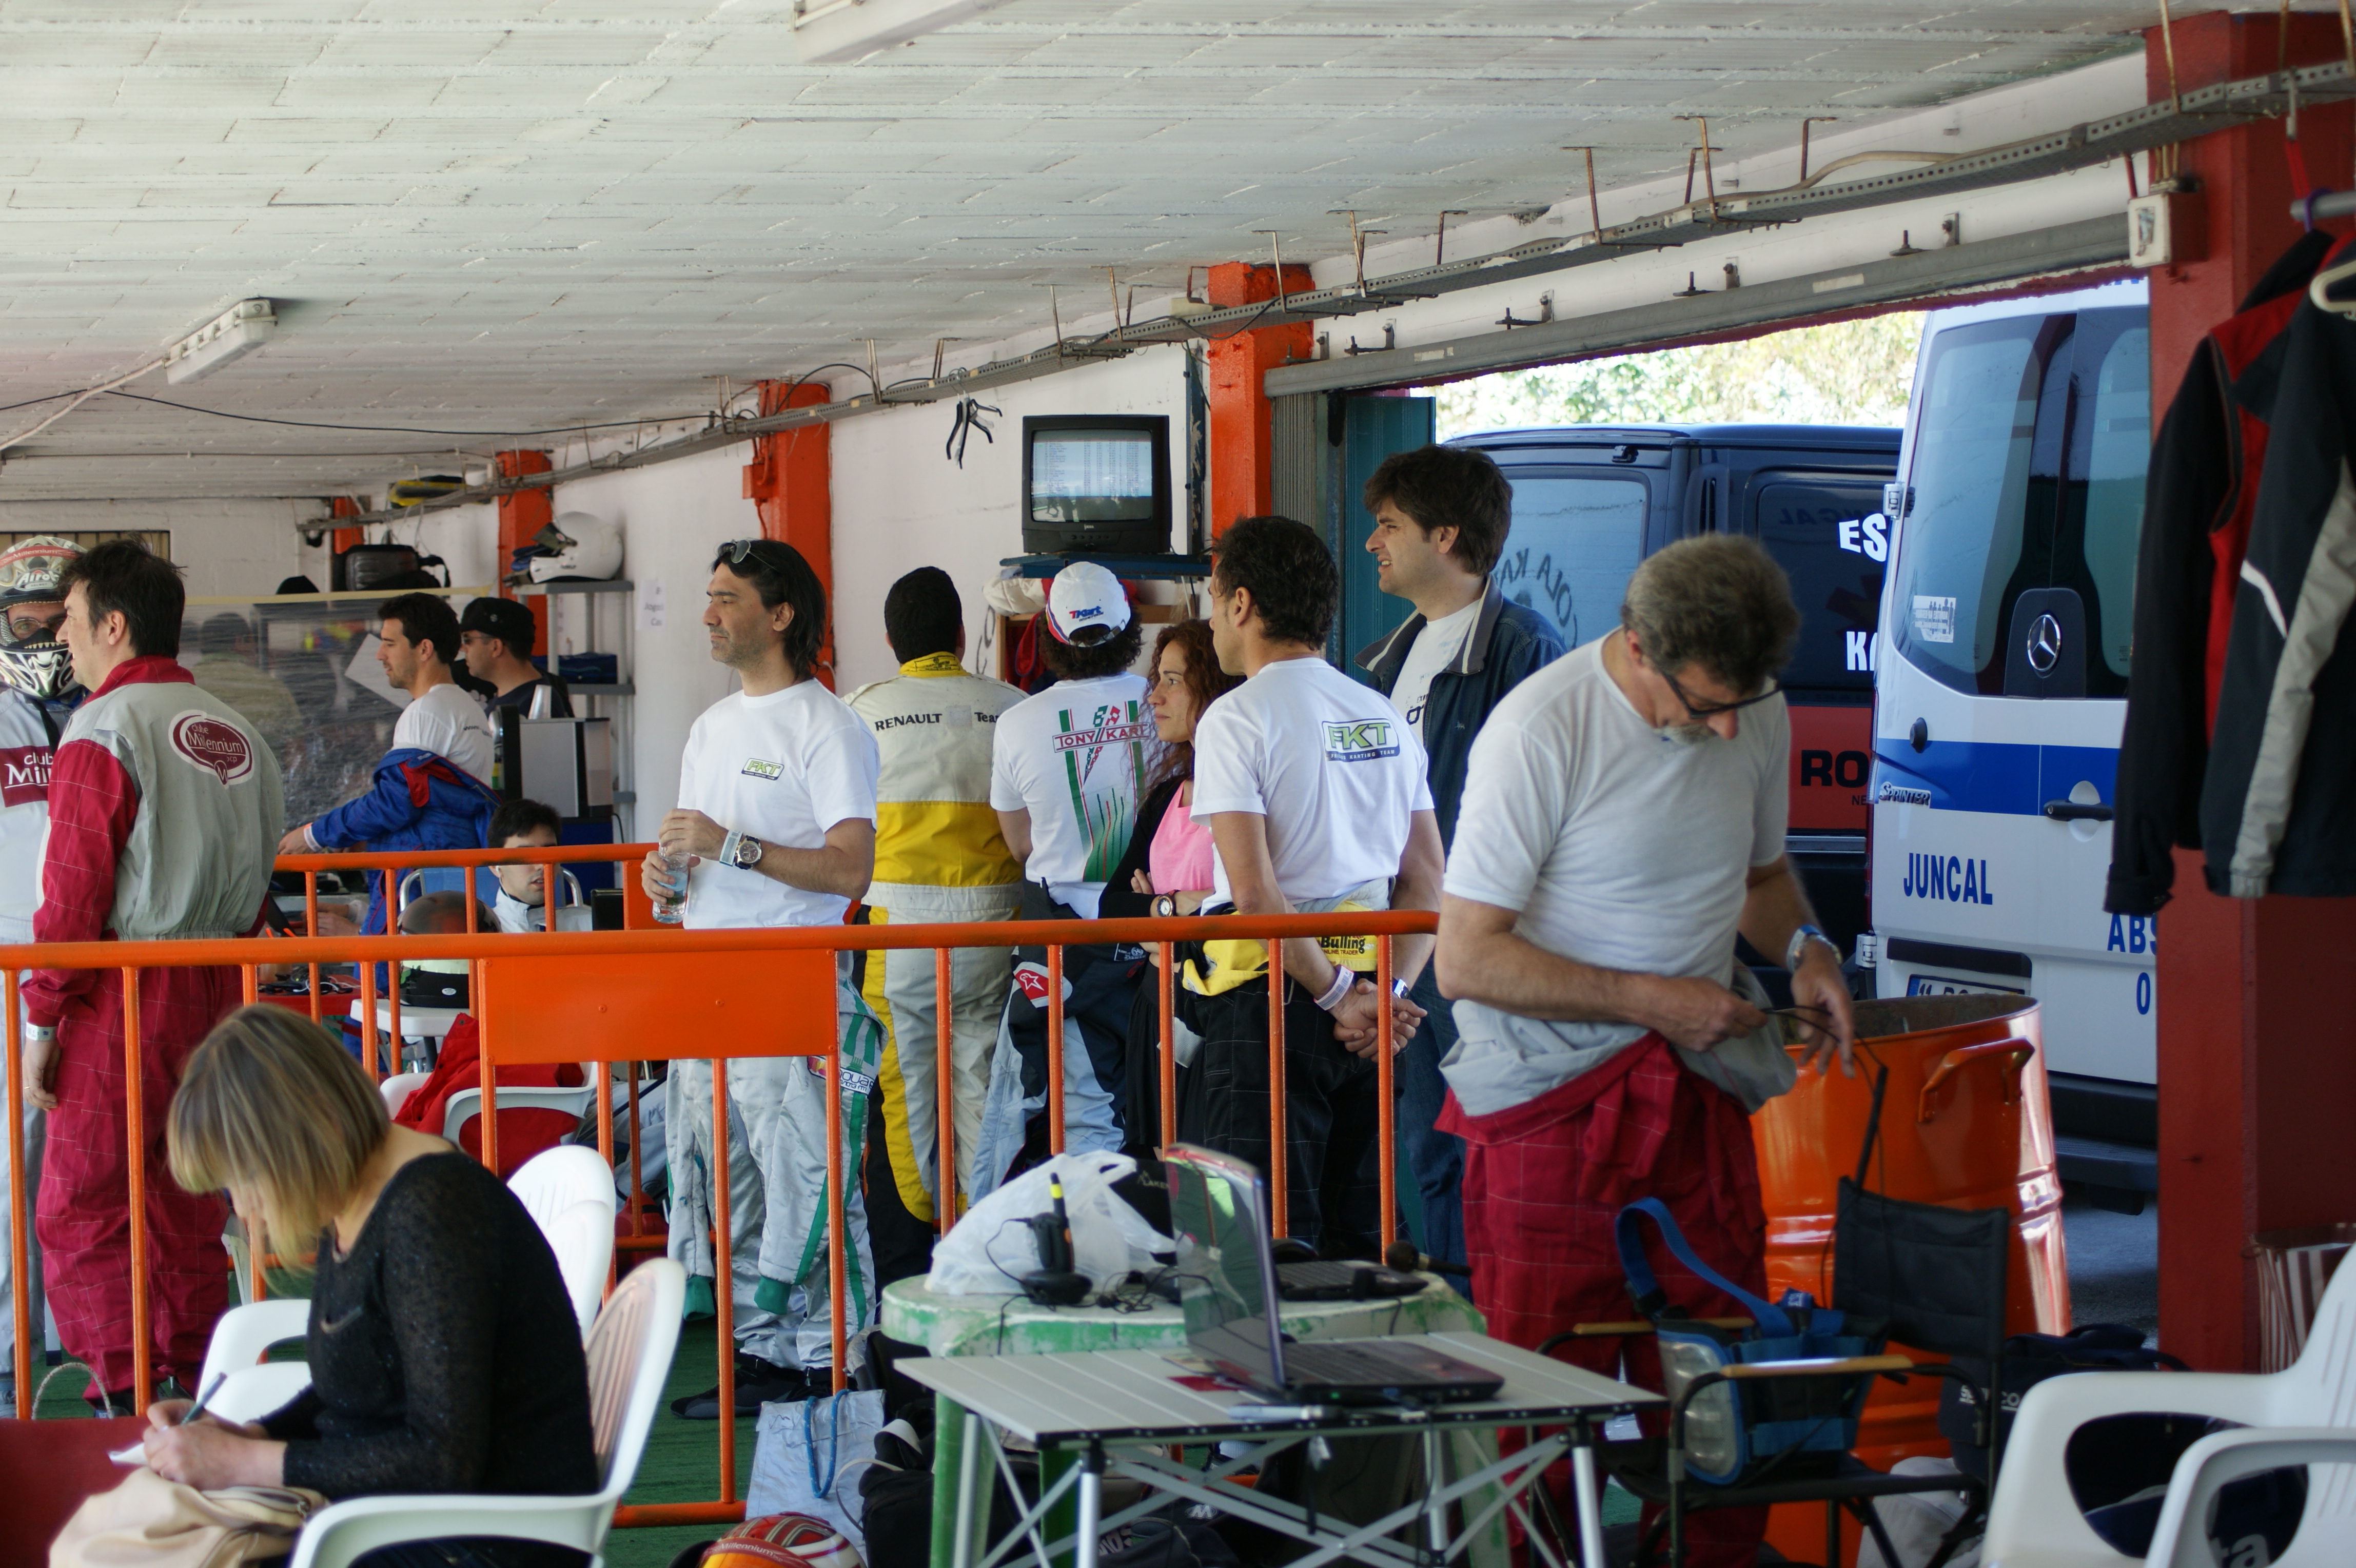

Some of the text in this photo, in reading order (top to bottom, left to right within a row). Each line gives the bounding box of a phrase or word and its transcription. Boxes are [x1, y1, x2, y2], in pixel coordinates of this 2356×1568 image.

[191, 723, 209, 734] clube
[874, 713, 943, 731] RENAULT
[186, 729, 243, 753] Millennium
[1055, 724, 1145, 748] TONY KART
[1327, 722, 1391, 750] FKT
[747, 760, 781, 775] FKT
[1903, 852, 1993, 906] JUNCAL
[720, 1542, 774, 1556] Millennium
